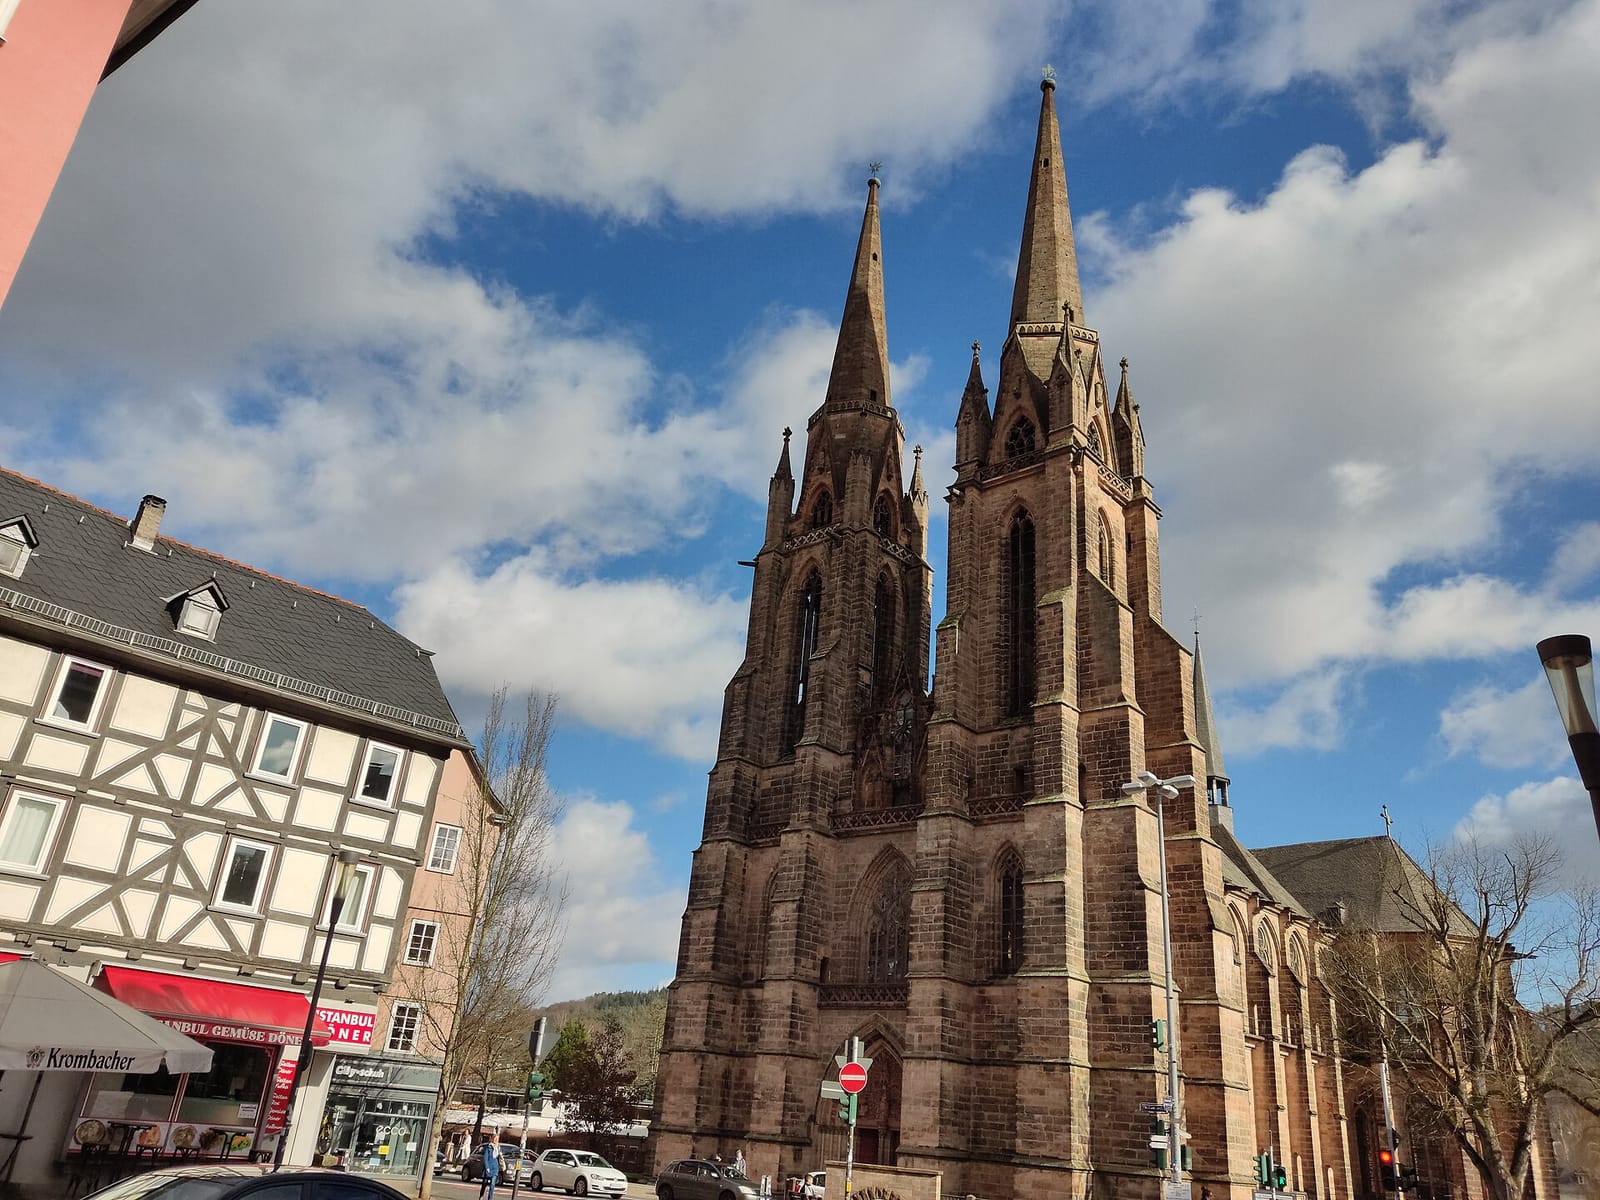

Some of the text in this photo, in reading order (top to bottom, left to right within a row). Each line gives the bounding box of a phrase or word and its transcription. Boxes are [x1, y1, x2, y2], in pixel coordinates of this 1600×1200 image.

[315, 1009, 373, 1028] STANBUL
[212, 1025, 265, 1042] GEMÜSE
[268, 1031, 303, 1045] DÖNE
[327, 1024, 372, 1042] ÖNER
[46, 1047, 136, 1071] Krombacher
[375, 1125, 406, 1136] ecco
